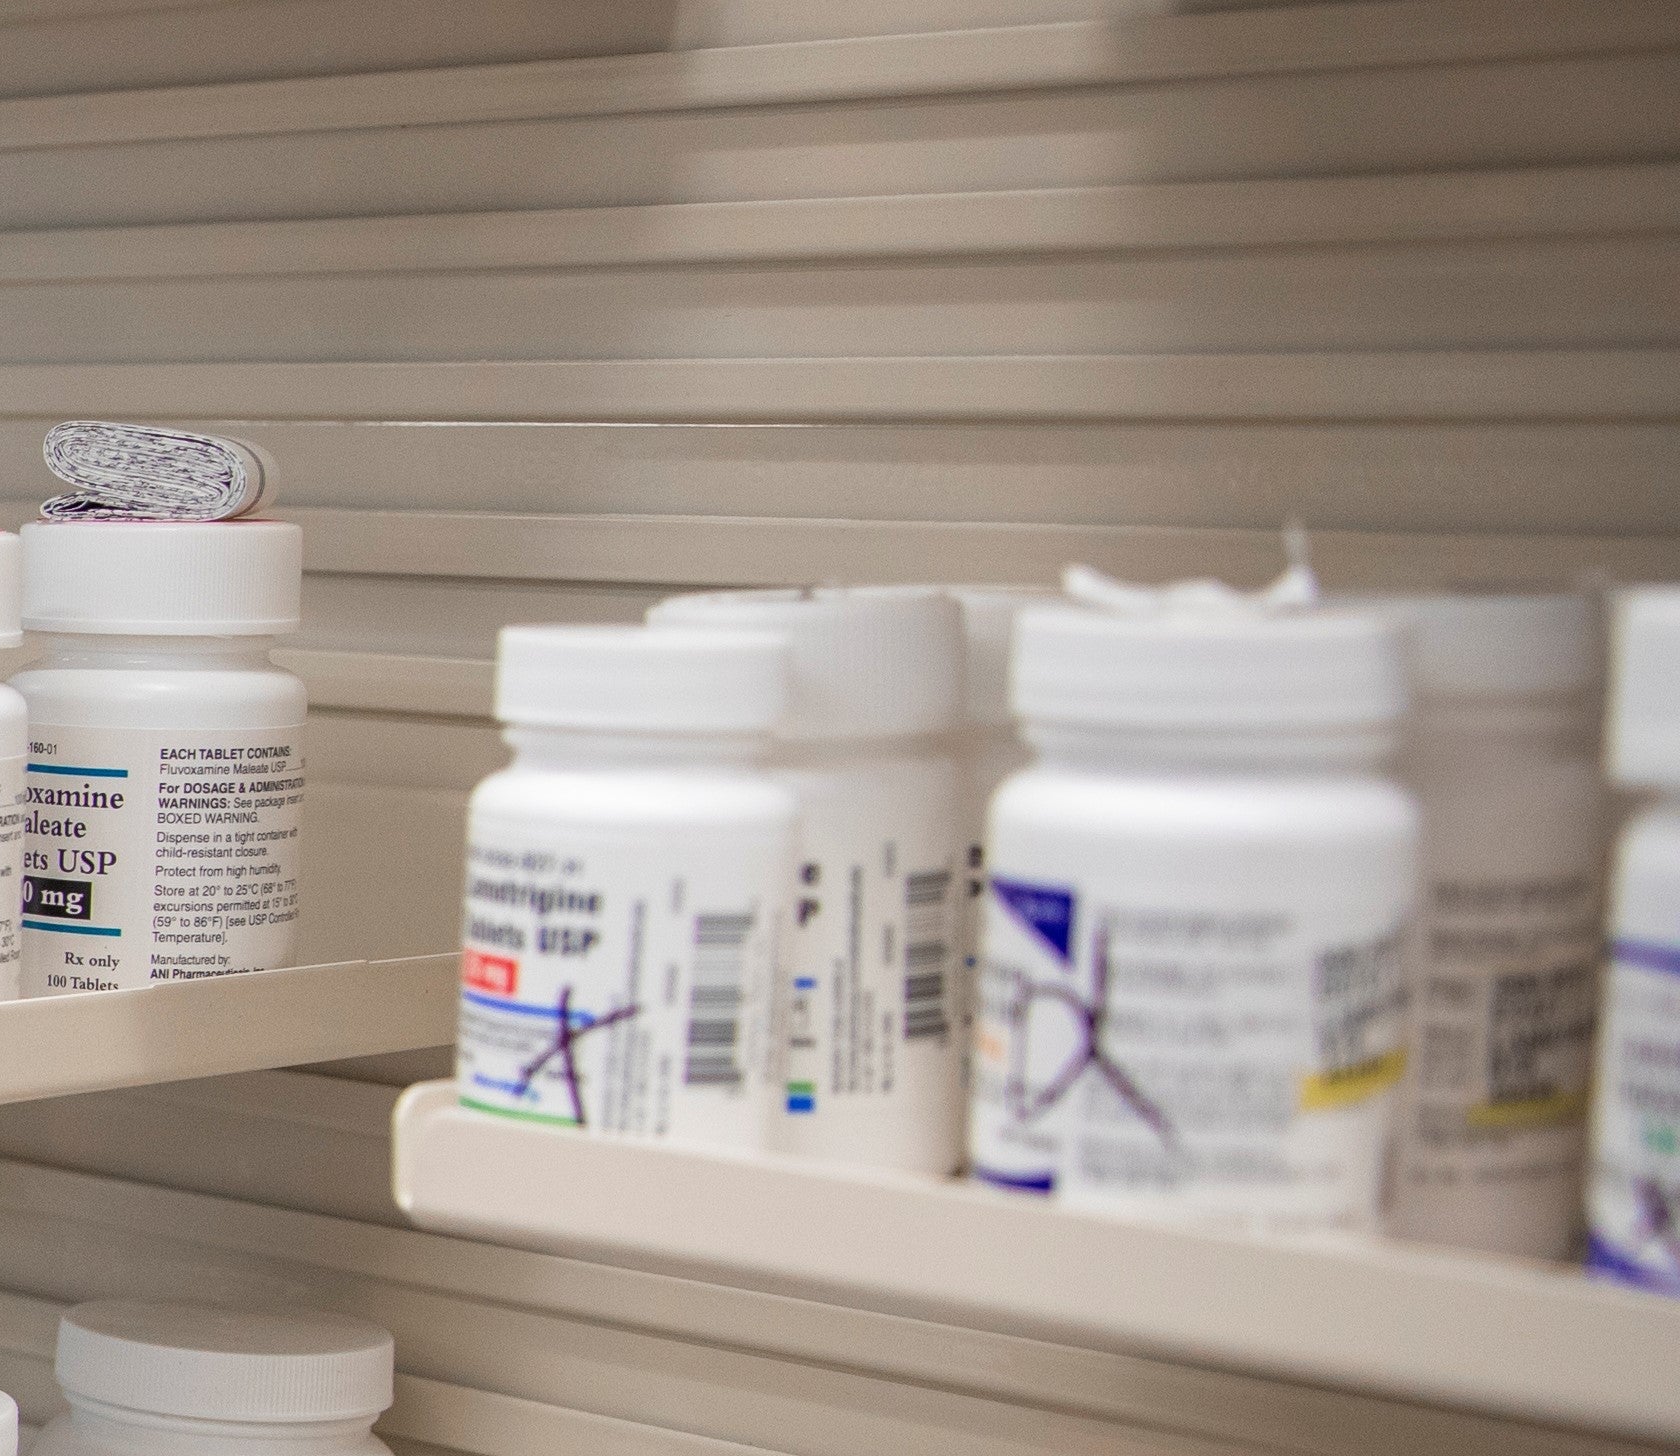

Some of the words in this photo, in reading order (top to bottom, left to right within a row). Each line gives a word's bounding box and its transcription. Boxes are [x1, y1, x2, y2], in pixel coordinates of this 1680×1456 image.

[160, 748, 196, 760] EACH
[199, 748, 244, 760] TABLET
[159, 763, 230, 775] Fluvoxamine
[233, 763, 270, 775] Maleate
[159, 783, 180, 794] For
[183, 783, 236, 794] DOSAGE
[238, 783, 246, 793] &
[158, 798, 231, 809] WARNINGS:
[233, 797, 252, 809] See
[254, 795, 286, 810] package
[157, 812, 202, 824] BOXED
[156, 831, 210, 845] Dispense
[213, 831, 222, 843] in
[225, 833, 232, 843] a
[235, 831, 255, 845] tight
[256, 829, 289, 842] container
[155, 848, 232, 859] child-resistant
[23, 850, 48, 871] ets
[57, 849, 117, 875] USP
[155, 865, 196, 877] Protect
[199, 865, 223, 877] from
[226, 865, 247, 879] high
[154, 884, 185, 897] Store
[188, 886, 199, 897] at
[202, 885, 221, 897] 20°
[223, 886, 233, 896] to
[235, 883, 259, 896] 25°C
[23, 881, 33, 902] 0
[40, 889, 84, 915] mg
[153, 901, 214, 913] excursions
[216, 900, 261, 913] permitted
[152, 916, 177, 929] (59°
[180, 917, 190, 928] to
[193, 916, 223, 929] 86°F)
[225, 915, 246, 930] [see
[248, 914, 267, 927] USP
[152, 931, 228, 946] Temperature].
[537, 926, 601, 954] USP
[64, 951, 84, 965] Rx
[88, 955, 120, 971] only
[150, 954, 216, 966] Manufactured
[150, 969, 169, 979] ANI
[47, 974, 67, 987] 100
[70, 976, 119, 991] Tablets
